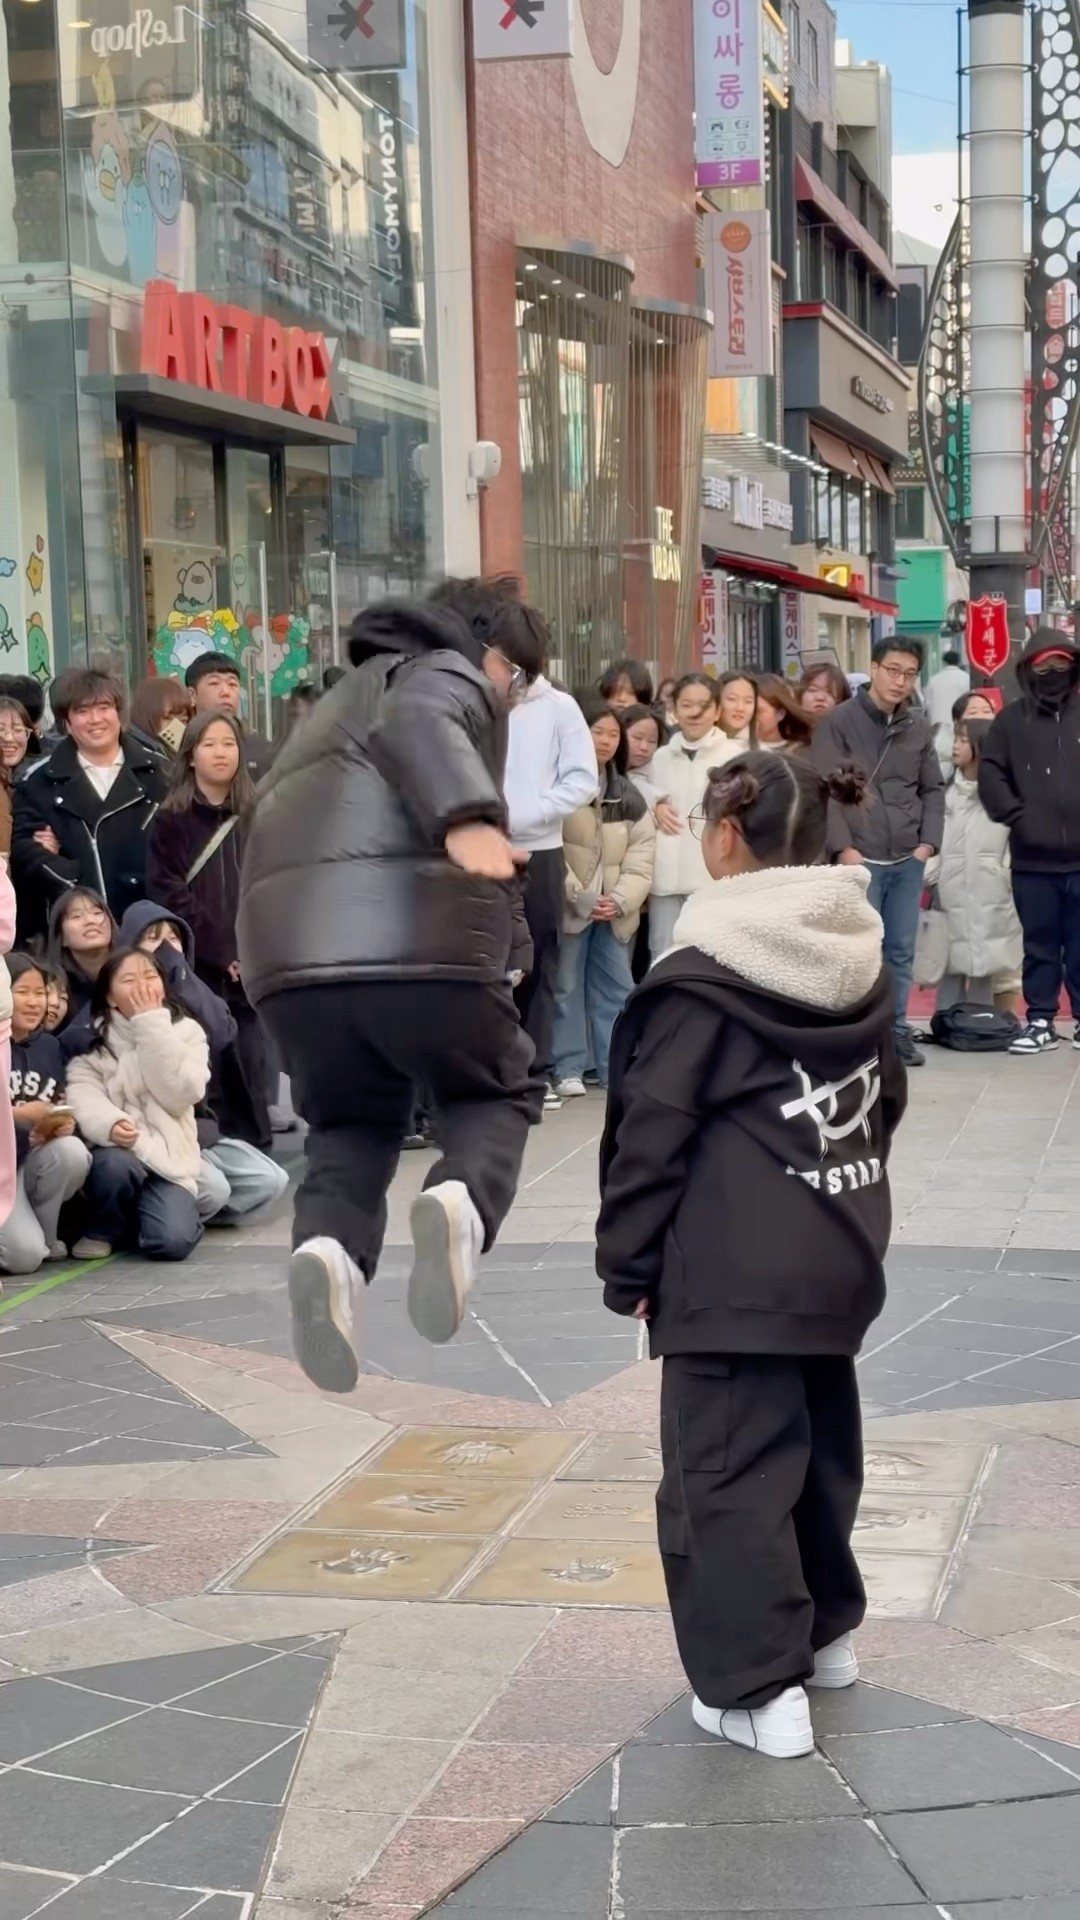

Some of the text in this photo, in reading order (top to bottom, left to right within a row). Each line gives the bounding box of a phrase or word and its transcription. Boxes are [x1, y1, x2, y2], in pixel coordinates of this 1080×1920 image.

[719, 163, 742, 181] 3F
[725, 255, 747, 357] 샤브스토리
[655, 505, 674, 545] THE
[981, 606, 998, 667] 구세군
